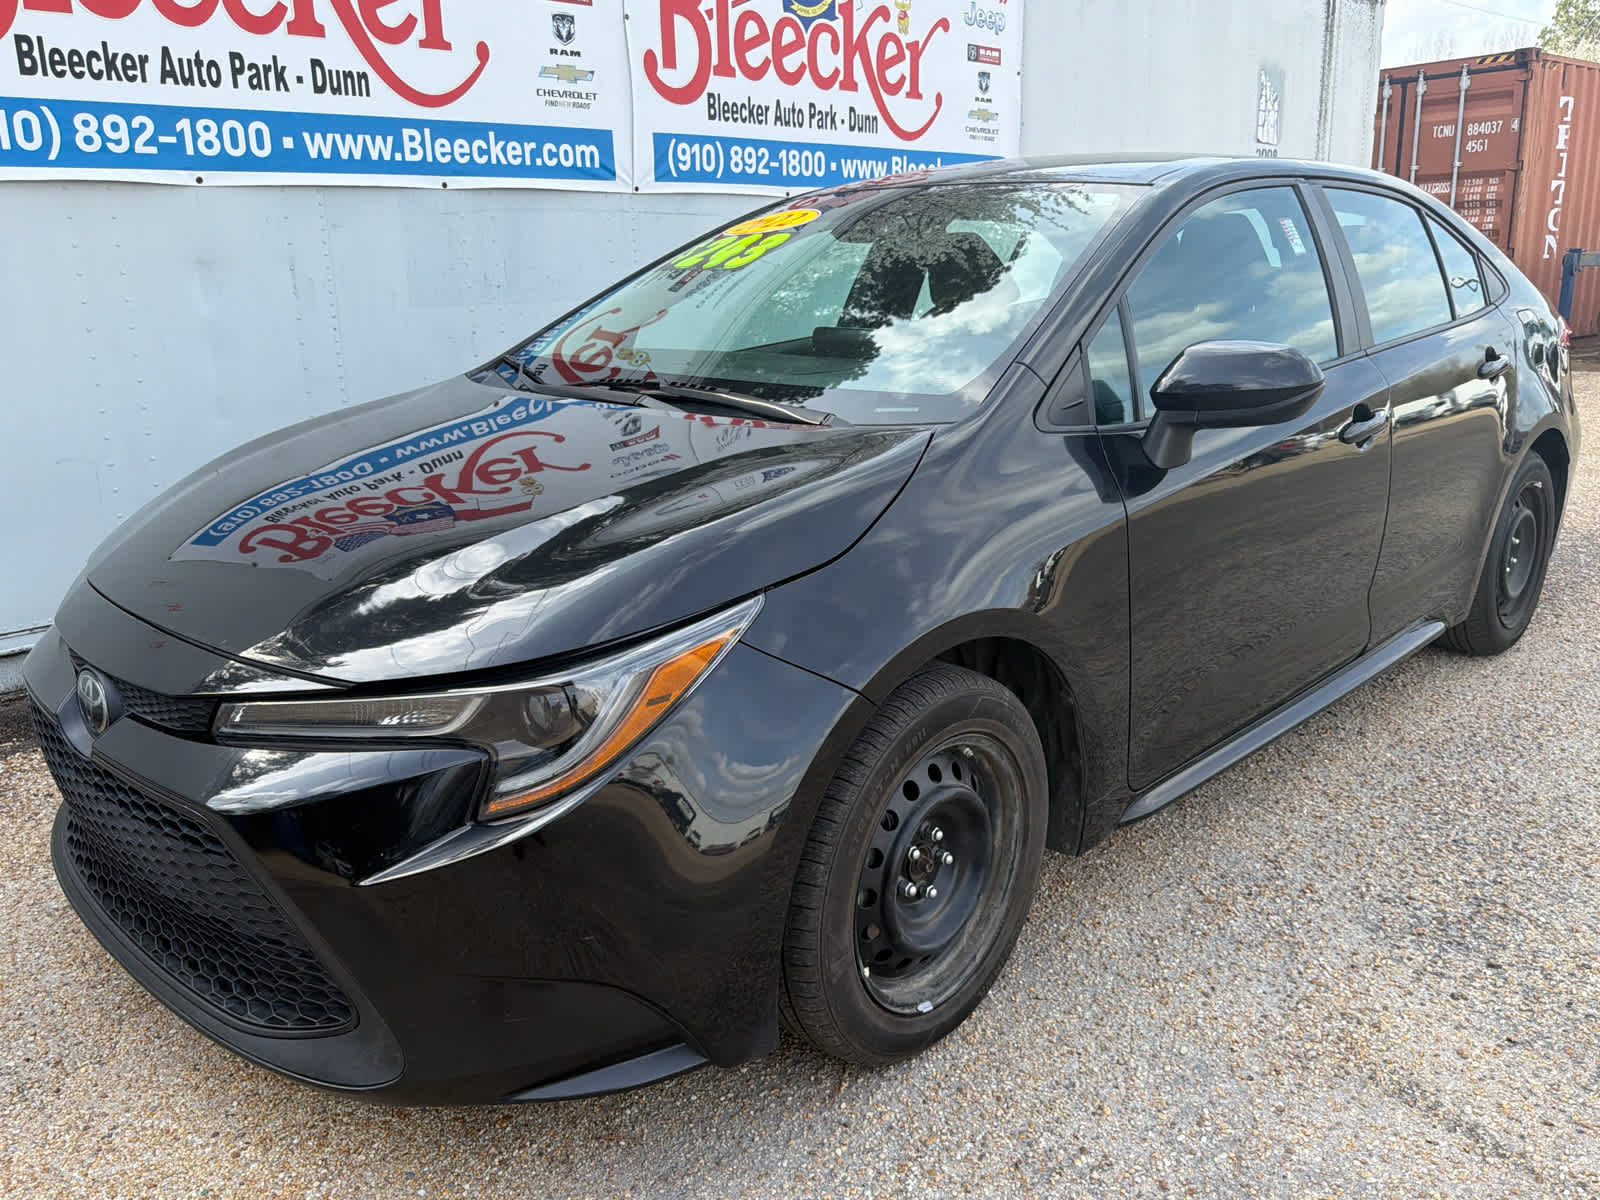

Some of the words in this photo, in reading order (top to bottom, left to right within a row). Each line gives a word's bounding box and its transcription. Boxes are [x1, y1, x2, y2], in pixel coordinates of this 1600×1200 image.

[964, 1, 1006, 35] Jeep
[14, 33, 149, 83] Bleecker
[160, 45, 221, 88] Auto
[229, 50, 290, 93] Park
[310, 58, 371, 98] Dunn
[549, 48, 582, 57] RAM
[643, 0, 950, 141] Bleecker
[536, 88, 598, 101] CHEVROLET
[707, 92, 770, 125] Bleecker
[774, 99, 804, 128] Auto
[808, 102, 837, 131] Park
[849, 106, 879, 134] Dunn
[73, 112, 272, 158] 892-1800
[302, 127, 600, 168] www.Bleecker.com
[1432, 124, 1455, 138] TCNU
[1467, 120, 1503, 136] 884037
[1466, 139, 1489, 153] 45G1
[668, 138, 724, 178] (910)
[730, 145, 826, 178] 892-1800
